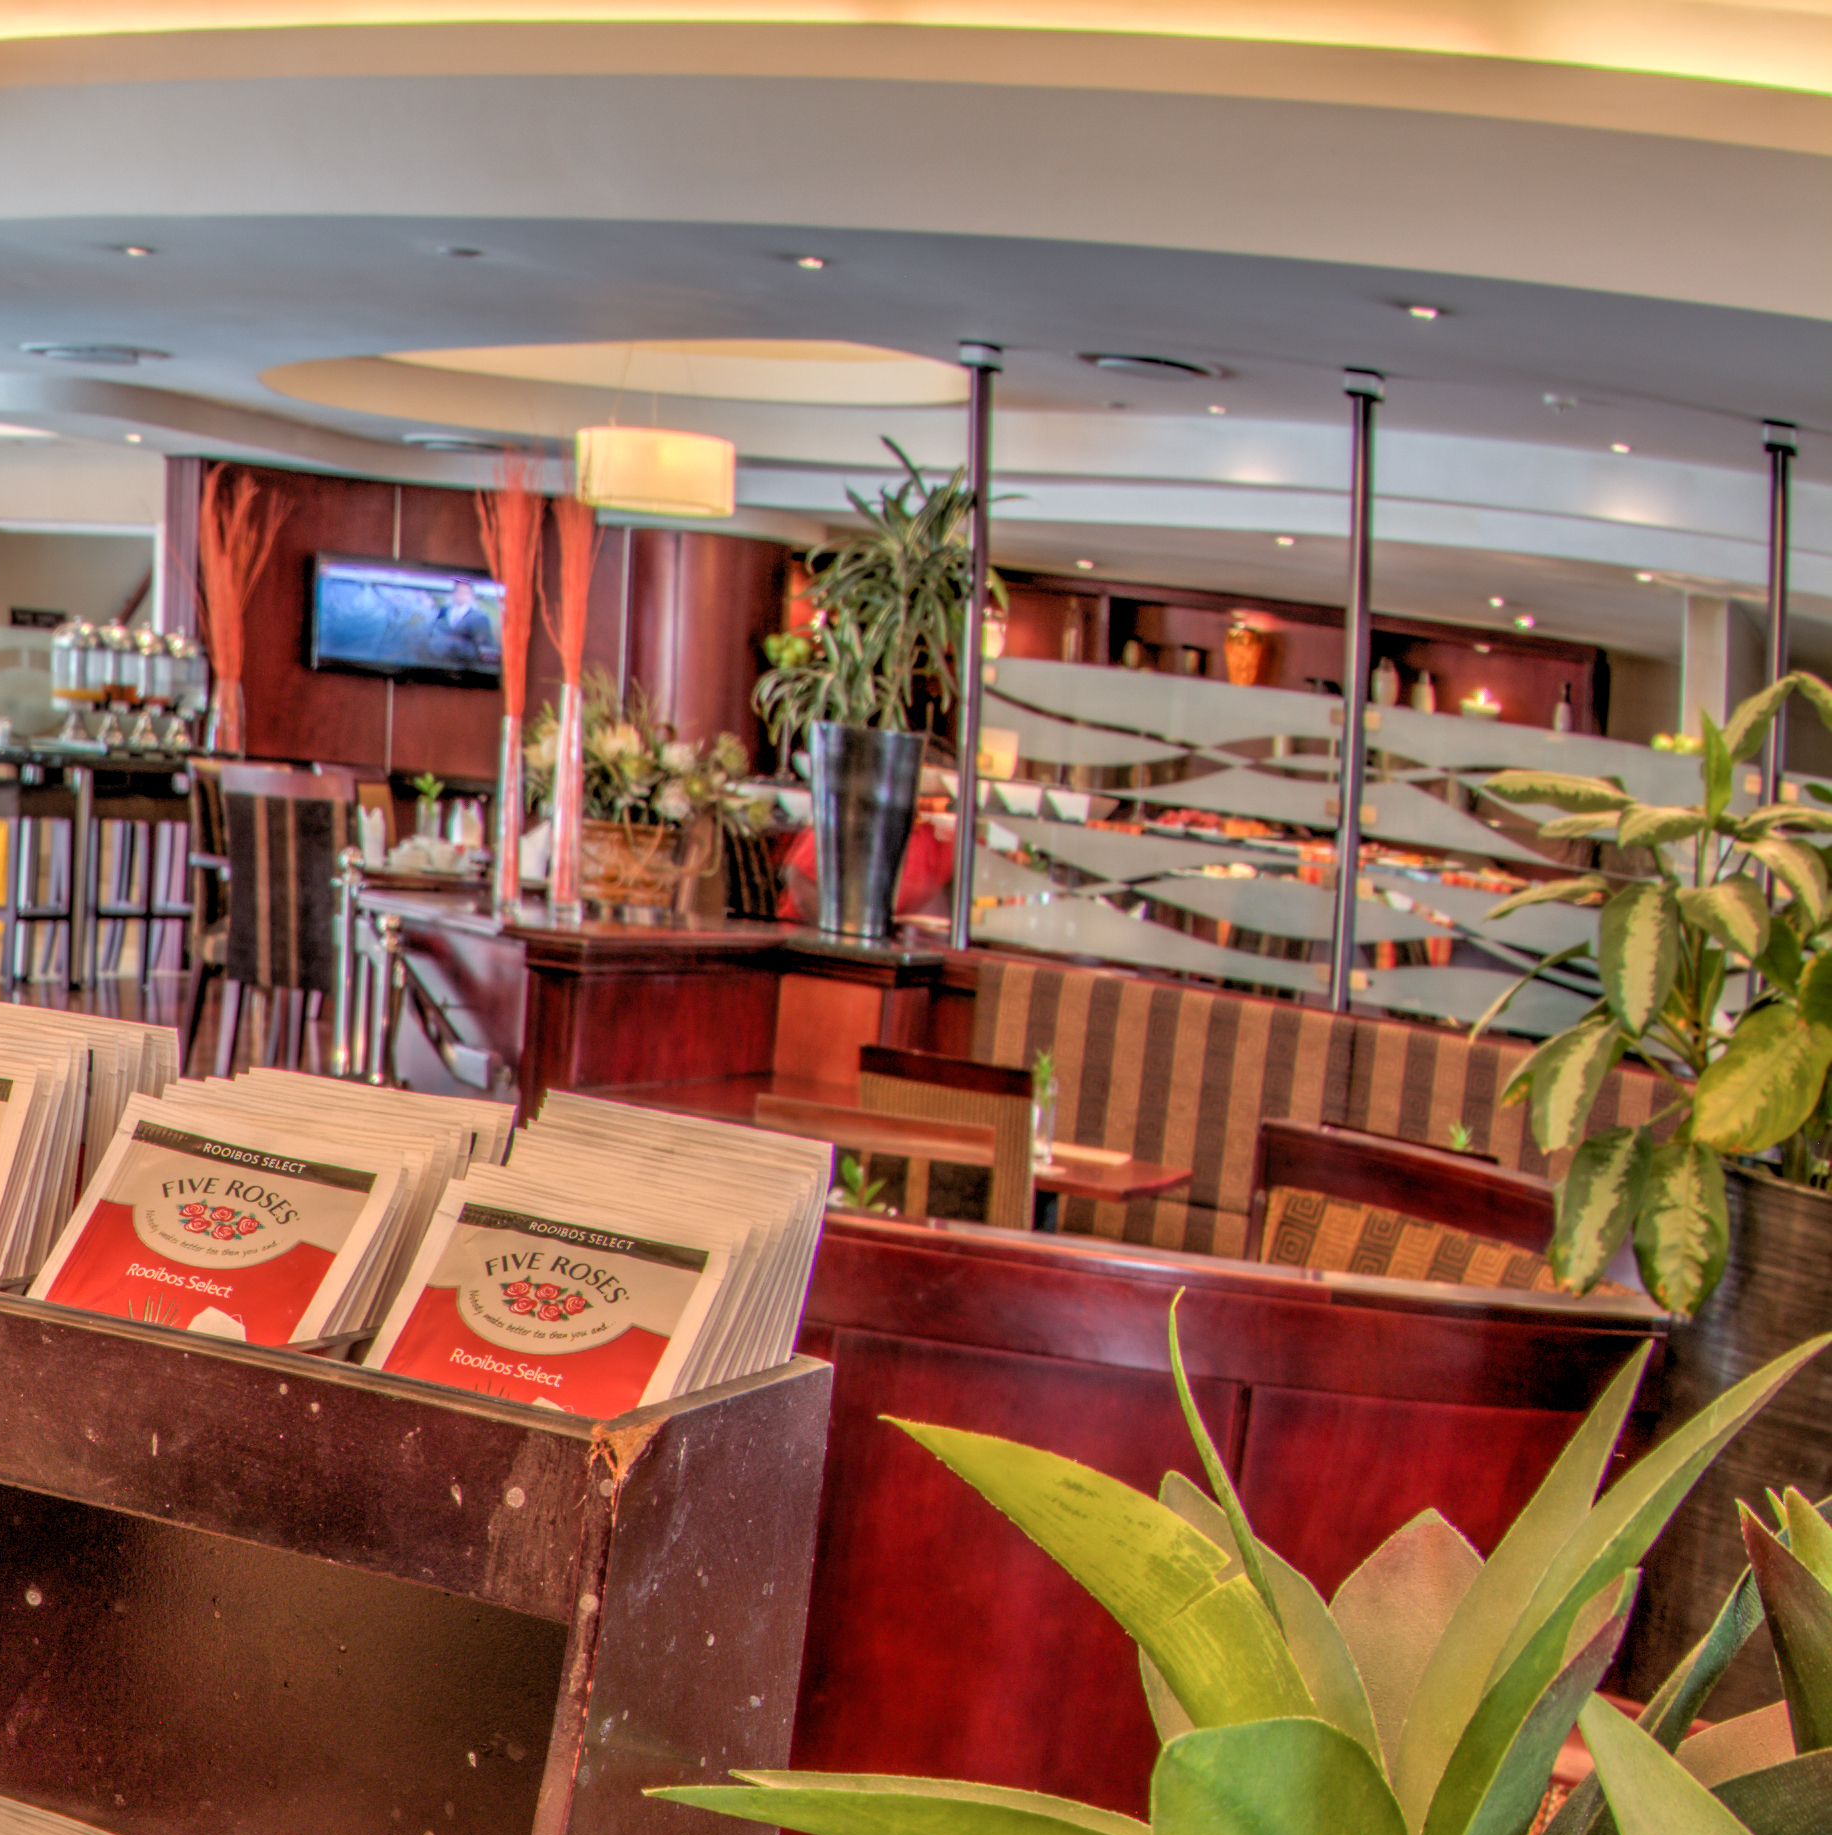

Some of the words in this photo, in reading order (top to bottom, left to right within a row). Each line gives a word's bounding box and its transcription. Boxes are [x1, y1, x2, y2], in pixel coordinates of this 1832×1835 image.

[203, 1143, 260, 1164] ROOIBOS
[261, 1157, 306, 1174] SELECT
[162, 1177, 220, 1198] FIVE
[225, 1180, 298, 1225] ROSES
[529, 1222, 586, 1241] ROOIBOS
[588, 1234, 634, 1250] SELECT
[126, 1264, 186, 1287] Rooibos
[185, 1276, 233, 1298] Select
[485, 1252, 544, 1277] FIVE
[550, 1256, 627, 1304] ROSES
[449, 1348, 513, 1375] Rooibos
[513, 1363, 562, 1387] Select
